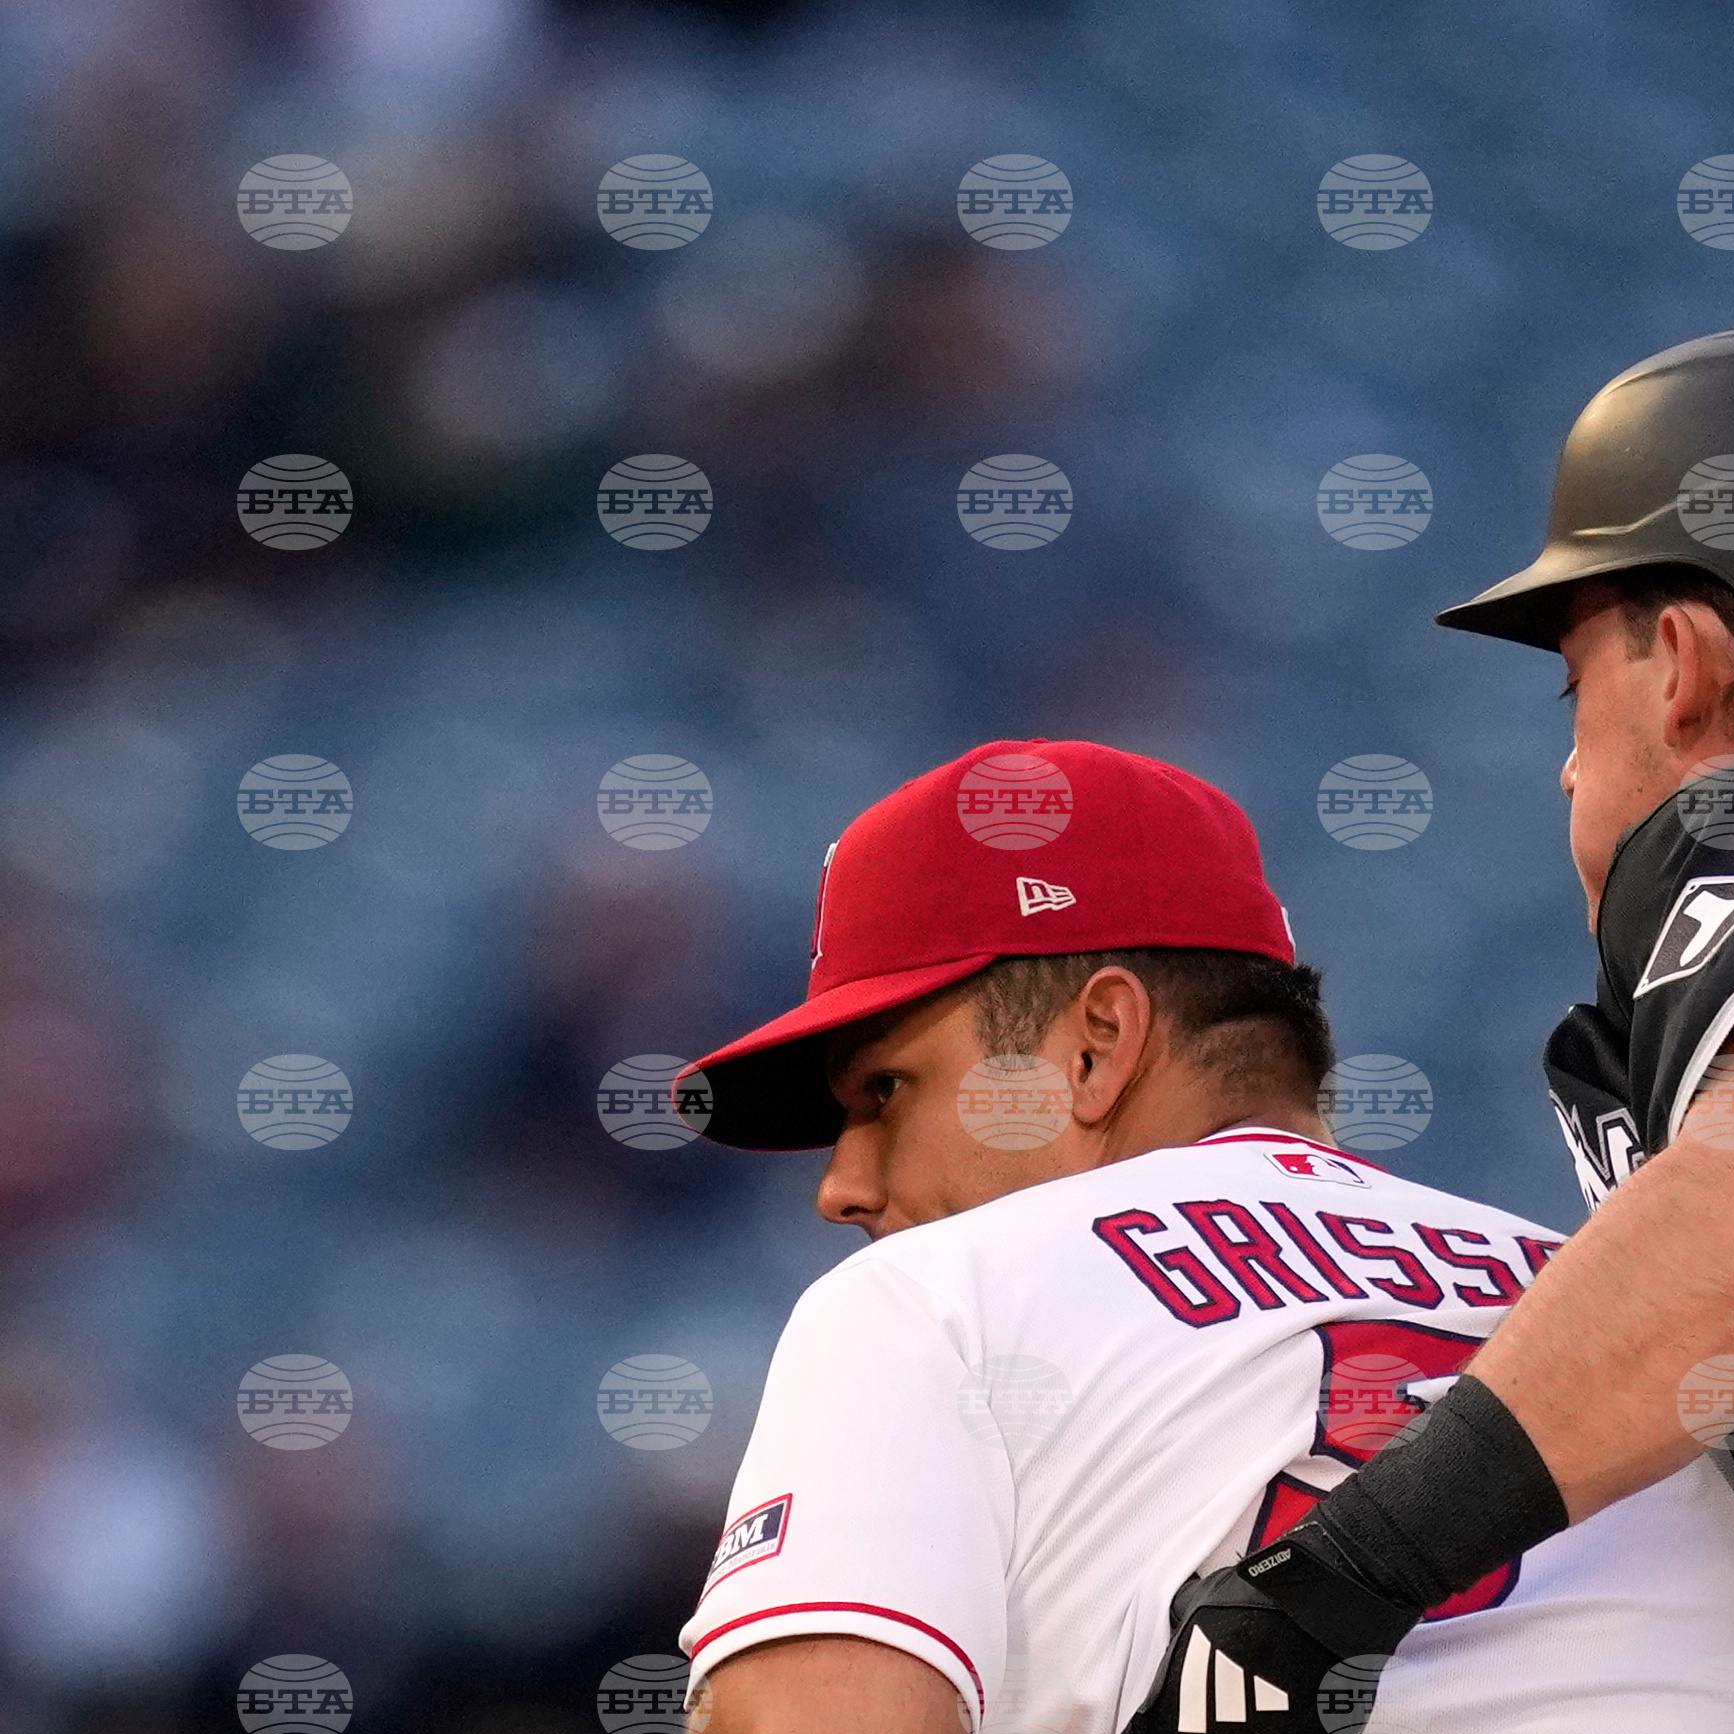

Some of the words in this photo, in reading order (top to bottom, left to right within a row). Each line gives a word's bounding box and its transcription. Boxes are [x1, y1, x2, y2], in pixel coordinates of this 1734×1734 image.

[1092, 1198, 1563, 1328] GRISS
[709, 1513, 769, 1574] BM
[1248, 1548, 1291, 1578] ADIZERO
